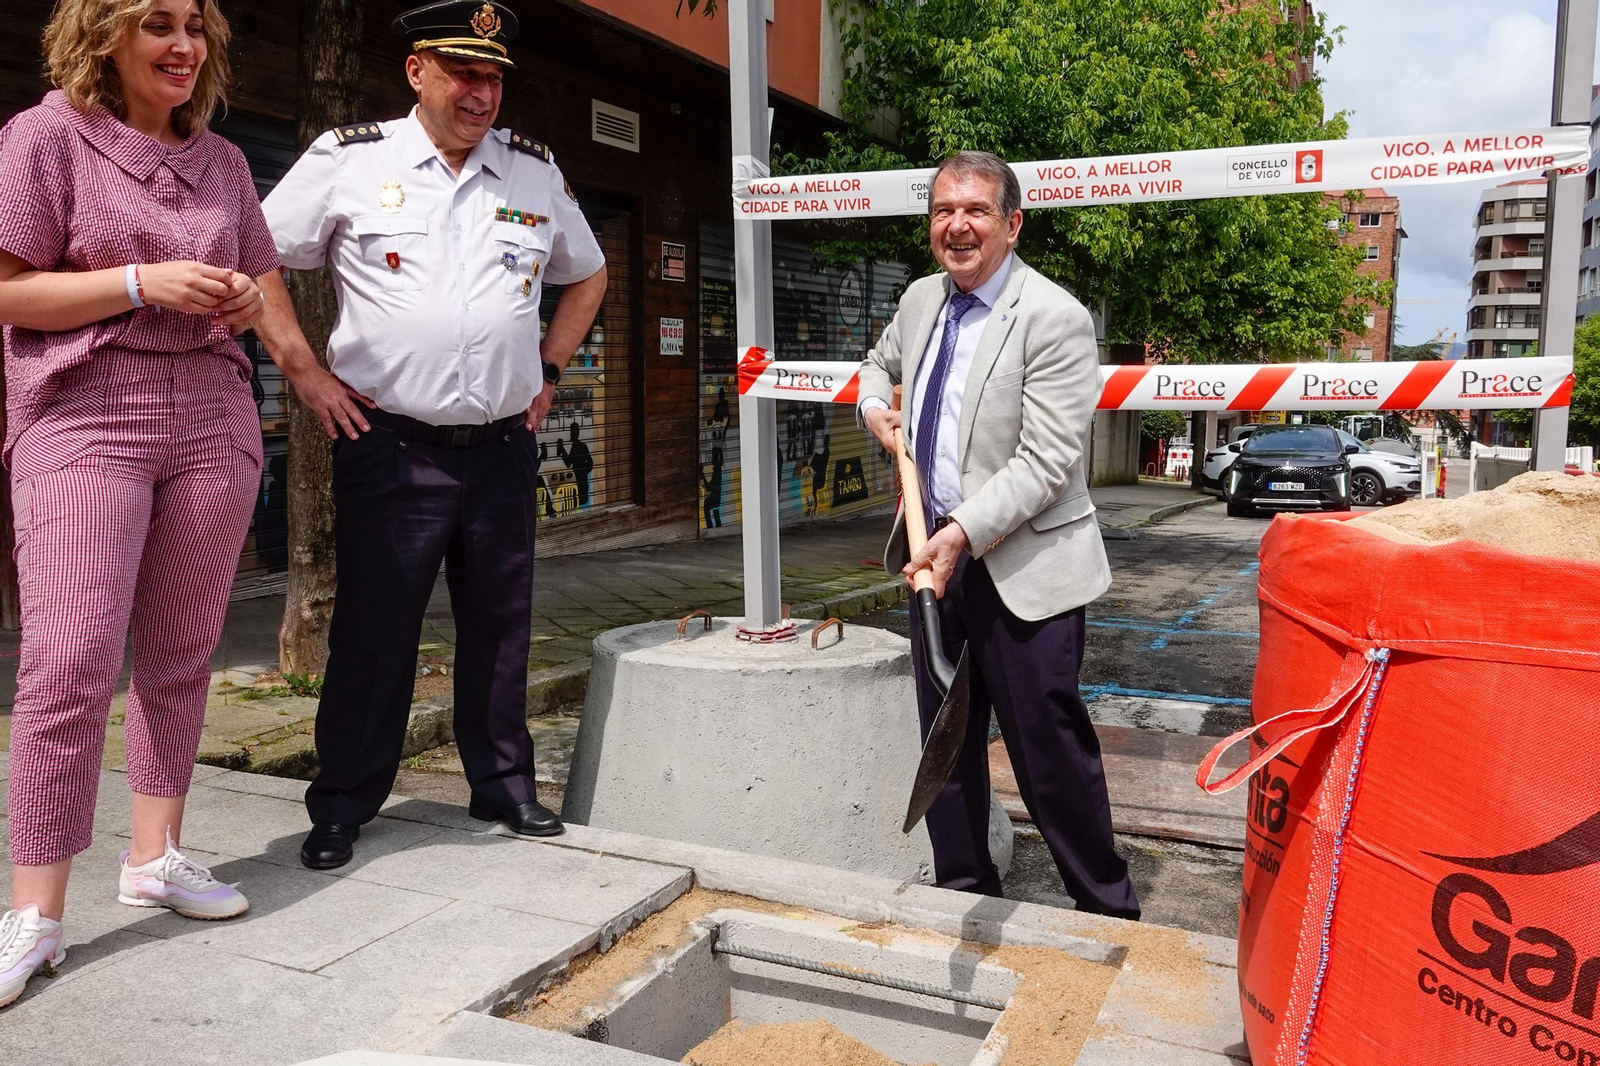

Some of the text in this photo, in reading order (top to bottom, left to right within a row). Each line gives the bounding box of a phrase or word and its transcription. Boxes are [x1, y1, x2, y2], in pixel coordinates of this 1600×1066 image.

[1383, 134, 1544, 158] VIGO, A MELLOR
[1036, 159, 1172, 181] VIGO, A MELLOR
[1232, 159, 1288, 171] CONCELLO
[1238, 170, 1281, 181] DE VIGO
[1370, 162, 1439, 180] CIDADE
[1446, 159, 1495, 176] PARA
[1503, 155, 1555, 172] VIVIR
[747, 178, 861, 196] VIGO, A MELLOR
[911, 182, 929, 191] CON
[917, 192, 929, 200] DE
[1027, 179, 1183, 202] CIDADE PARA VIVIR
[741, 197, 871, 214] CIDADE PARA VIVIR
[775, 368, 834, 389] Prace
[1155, 374, 1226, 397] Prace
[1301, 373, 1379, 397] Prace
[1459, 370, 1543, 393] Prace
[838, 477, 862, 495] TAMBO
[1248, 763, 1290, 835] nta
[1258, 1002, 1275, 1024] saco
[1417, 967, 1518, 1038] Centro
